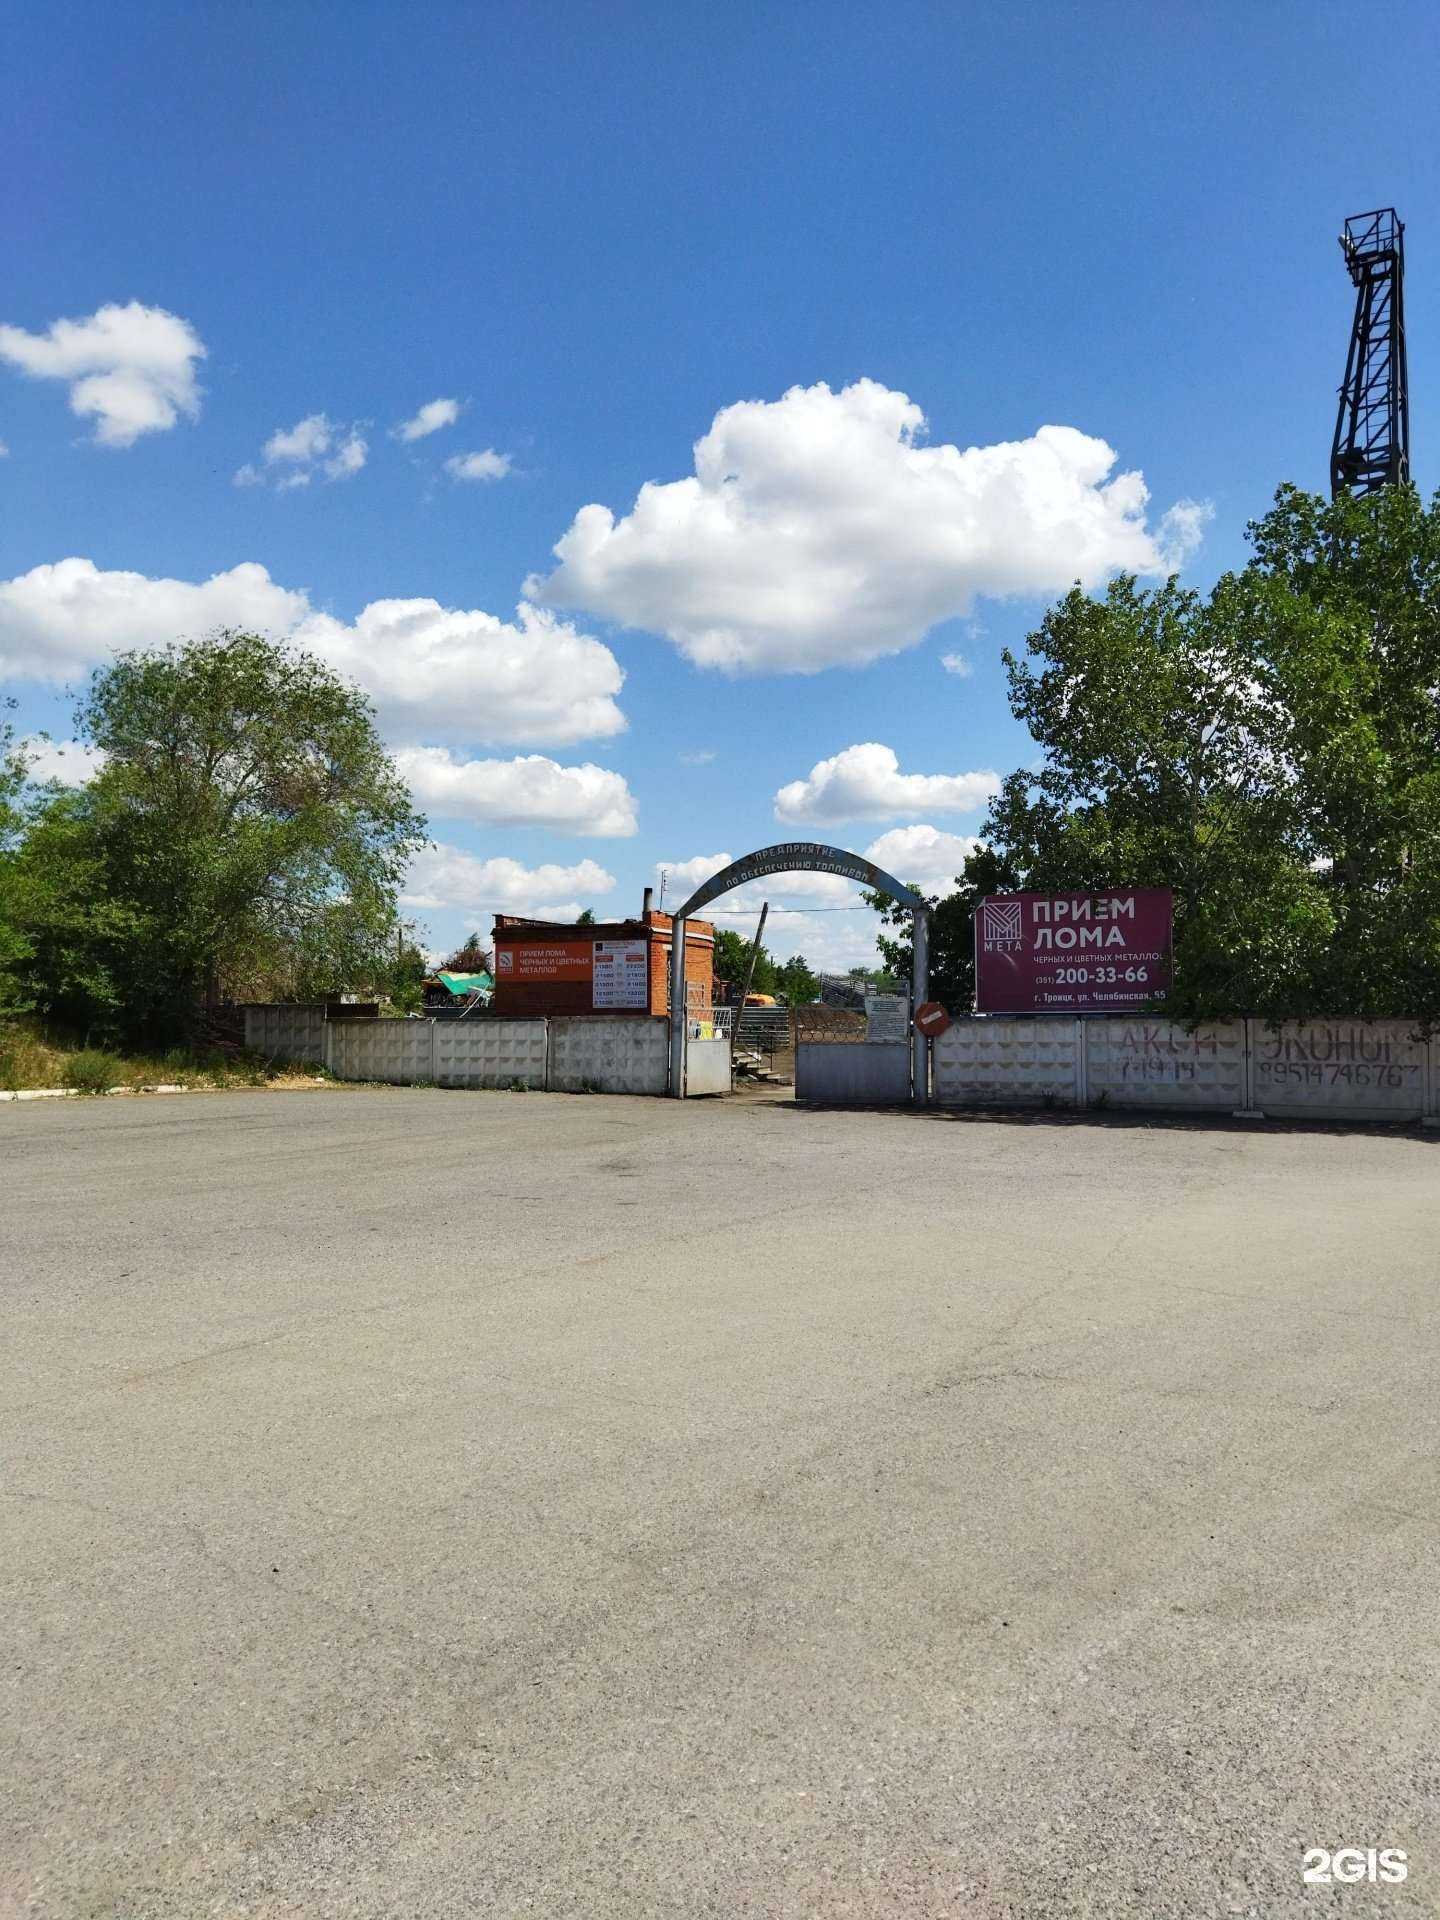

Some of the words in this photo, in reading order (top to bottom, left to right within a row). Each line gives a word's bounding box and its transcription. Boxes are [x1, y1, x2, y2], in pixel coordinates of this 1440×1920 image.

[754, 844, 836, 861] ПРЕДПРИЯТИЕ
[726, 877, 738, 888] ПО
[740, 860, 811, 881] ОБЕСПЕЧЕНИЮ
[1032, 897, 1135, 923] ПРИЕМ
[984, 940, 1022, 952] МЕТА
[1033, 925, 1126, 950] ЛОМА
[555, 957, 591, 966] ЦВЕТНЫХ
[1033, 955, 1066, 964] ЧЕРНЫХ
[1074, 954, 1112, 964] ЦВЕТНЫХ
[520, 966, 557, 974] МЕТАЛЛОВ
[1055, 966, 1148, 984] 200-33-66
